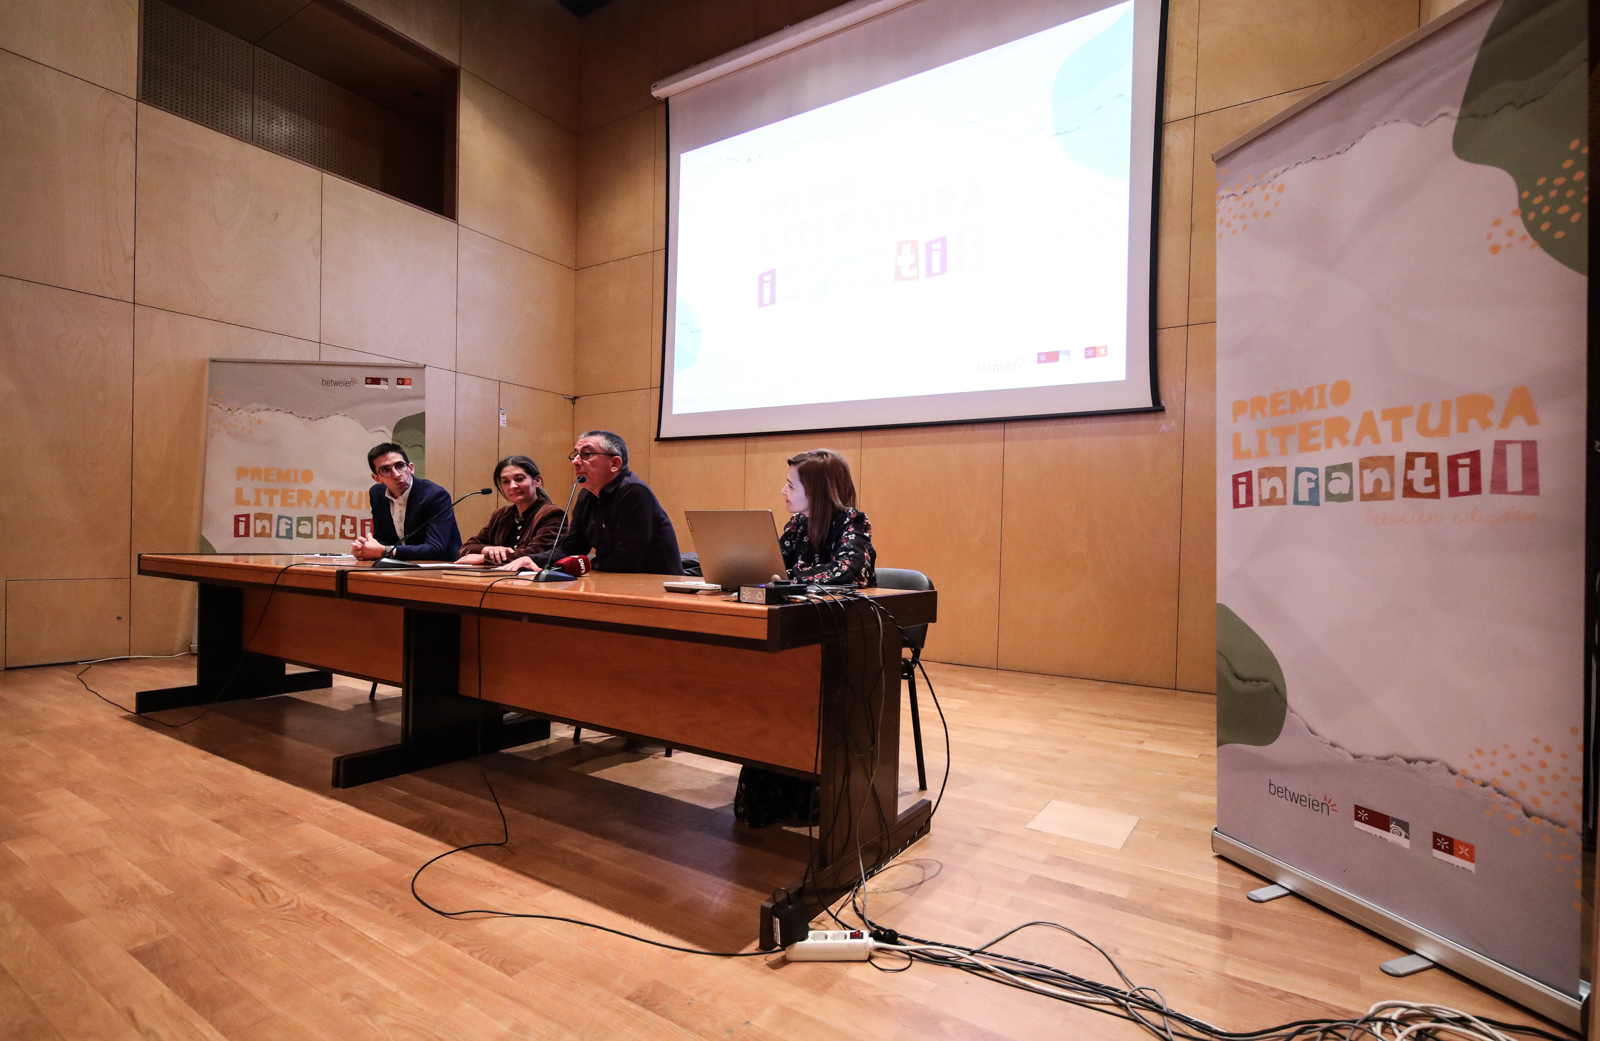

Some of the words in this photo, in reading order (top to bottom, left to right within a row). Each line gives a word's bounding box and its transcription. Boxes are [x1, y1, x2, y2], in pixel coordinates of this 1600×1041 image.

[321, 378, 355, 388] betweien
[1232, 379, 1351, 424] PRÉMIO
[1232, 385, 1540, 460] LITERATURA
[1232, 439, 1541, 510] infantil
[1268, 778, 1330, 817] betweien
